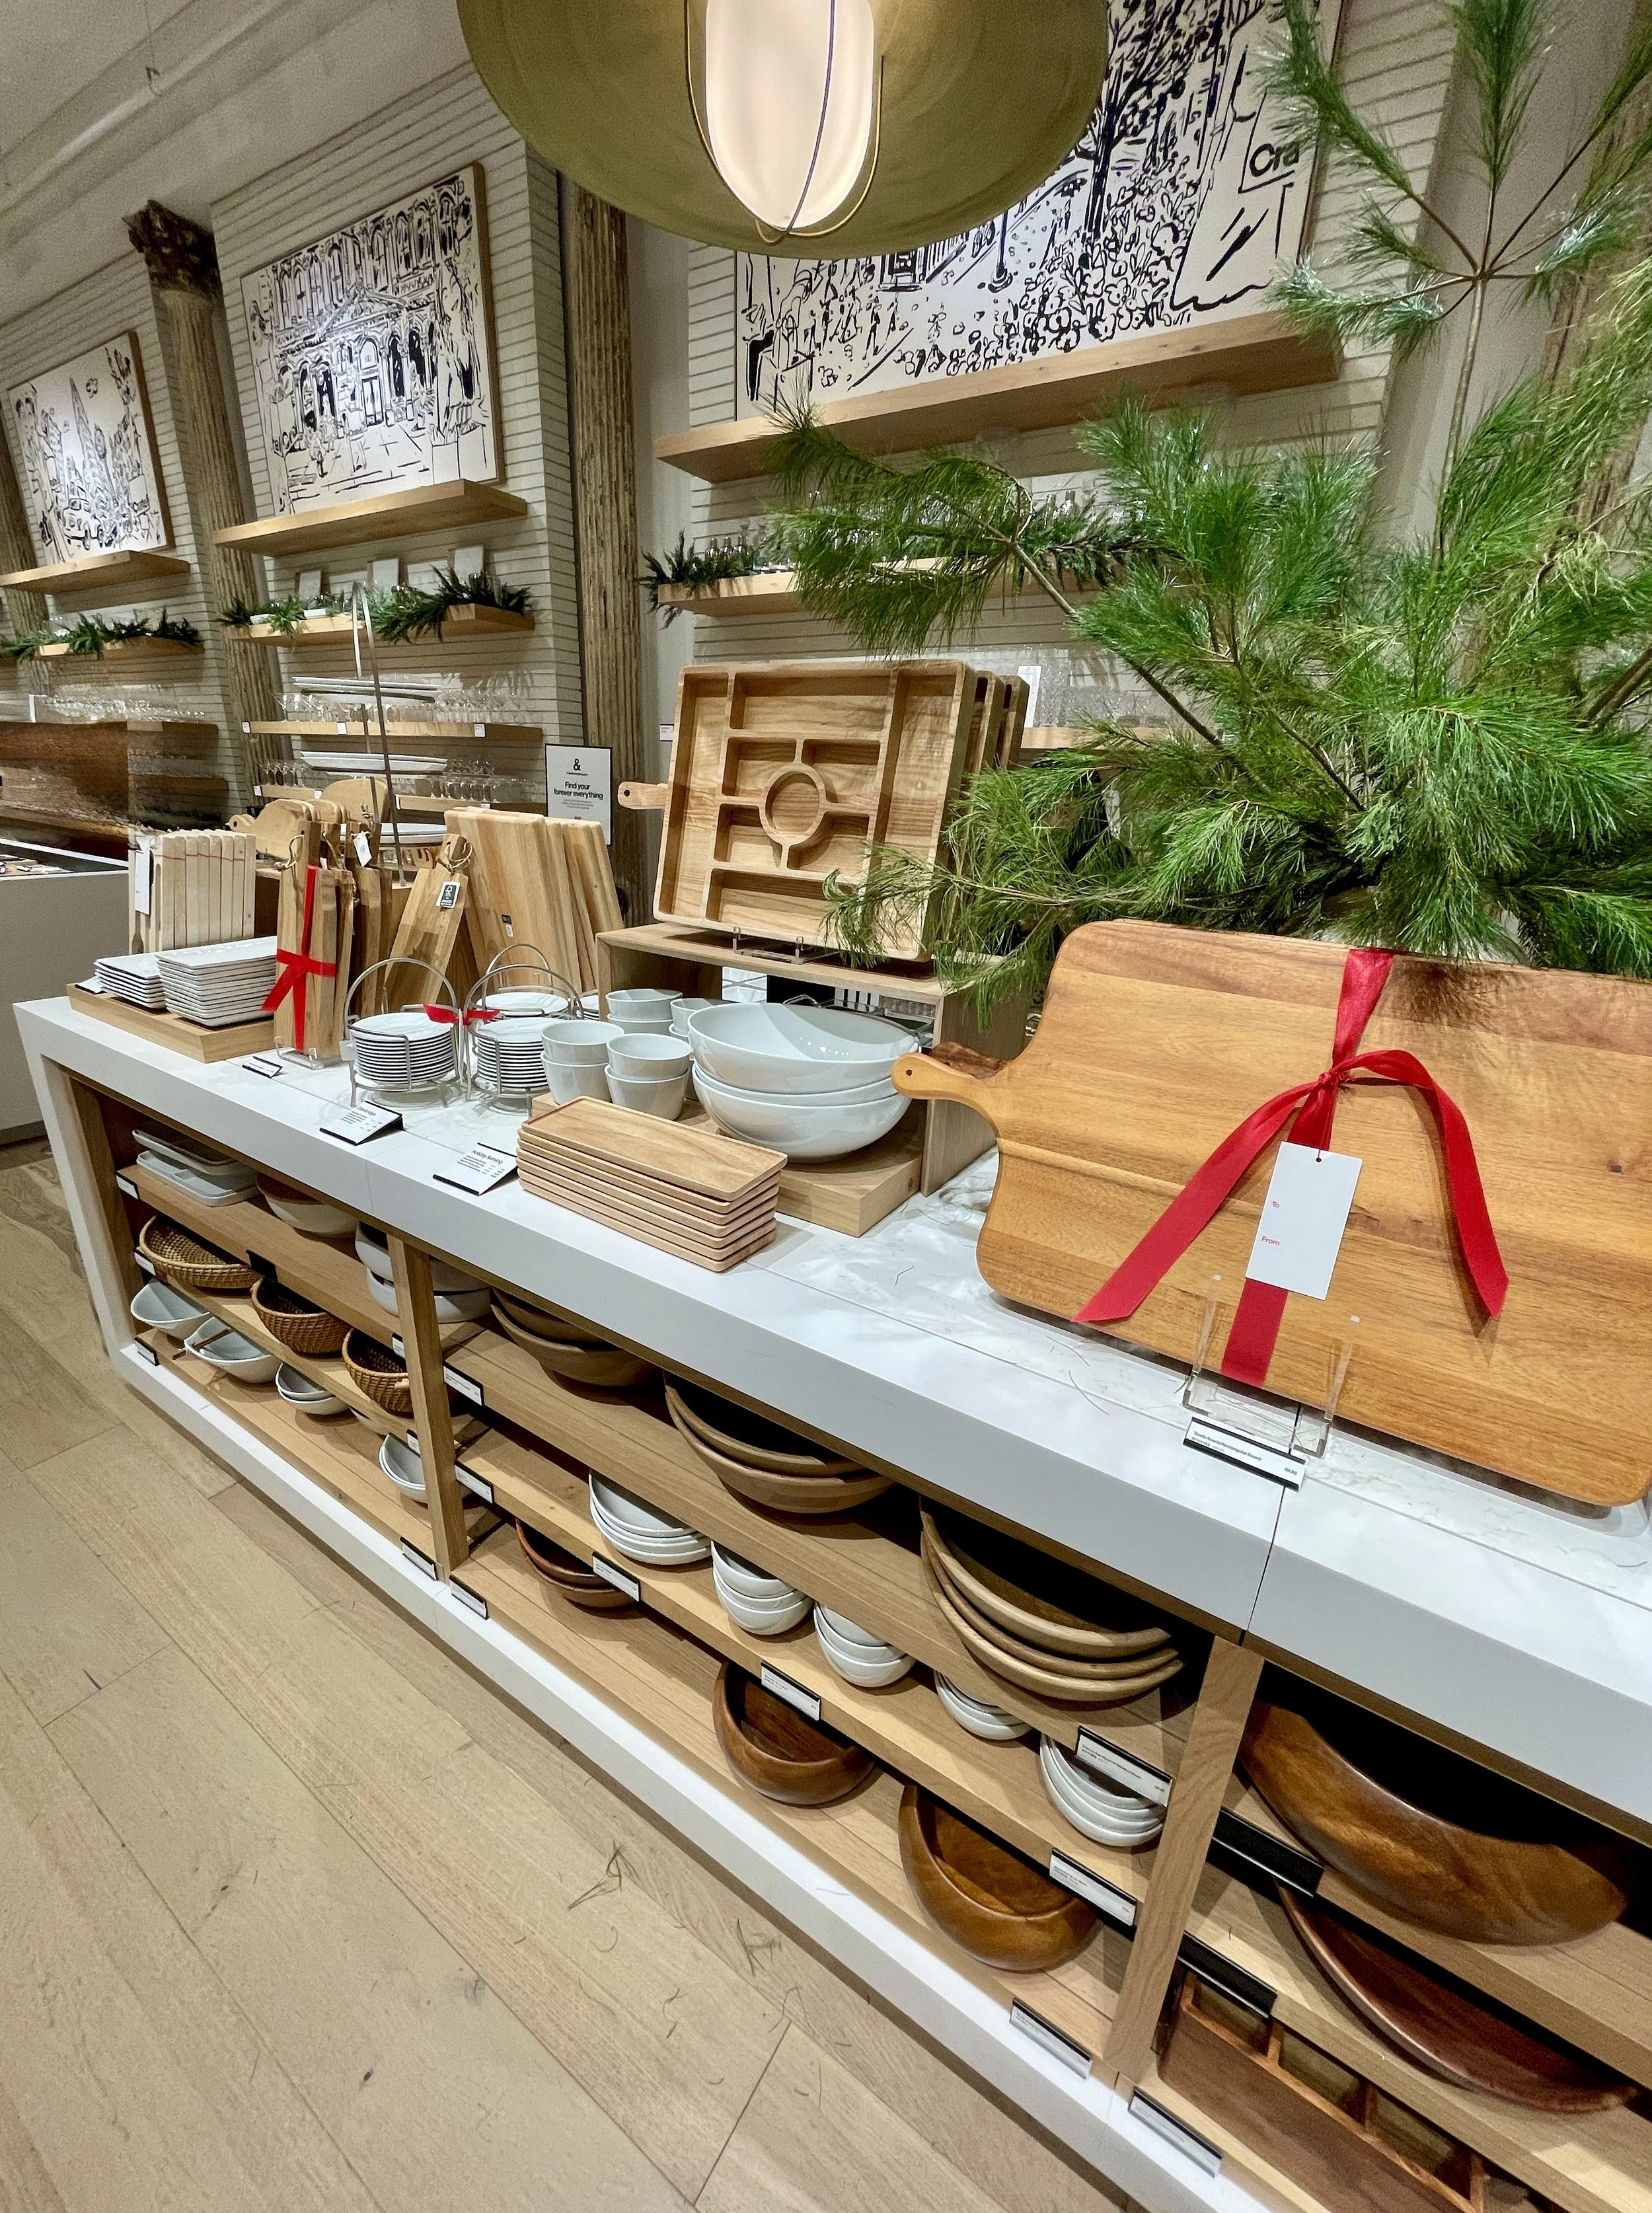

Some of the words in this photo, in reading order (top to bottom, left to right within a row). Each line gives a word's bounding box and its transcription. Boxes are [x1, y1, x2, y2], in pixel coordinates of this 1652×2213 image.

[573, 759, 581, 770] &
[573, 792, 603, 800] everything
[471, 1149, 488, 1159] Holiday
[486, 1155, 504, 1165] Serving
[1261, 1236, 1280, 1246] From
